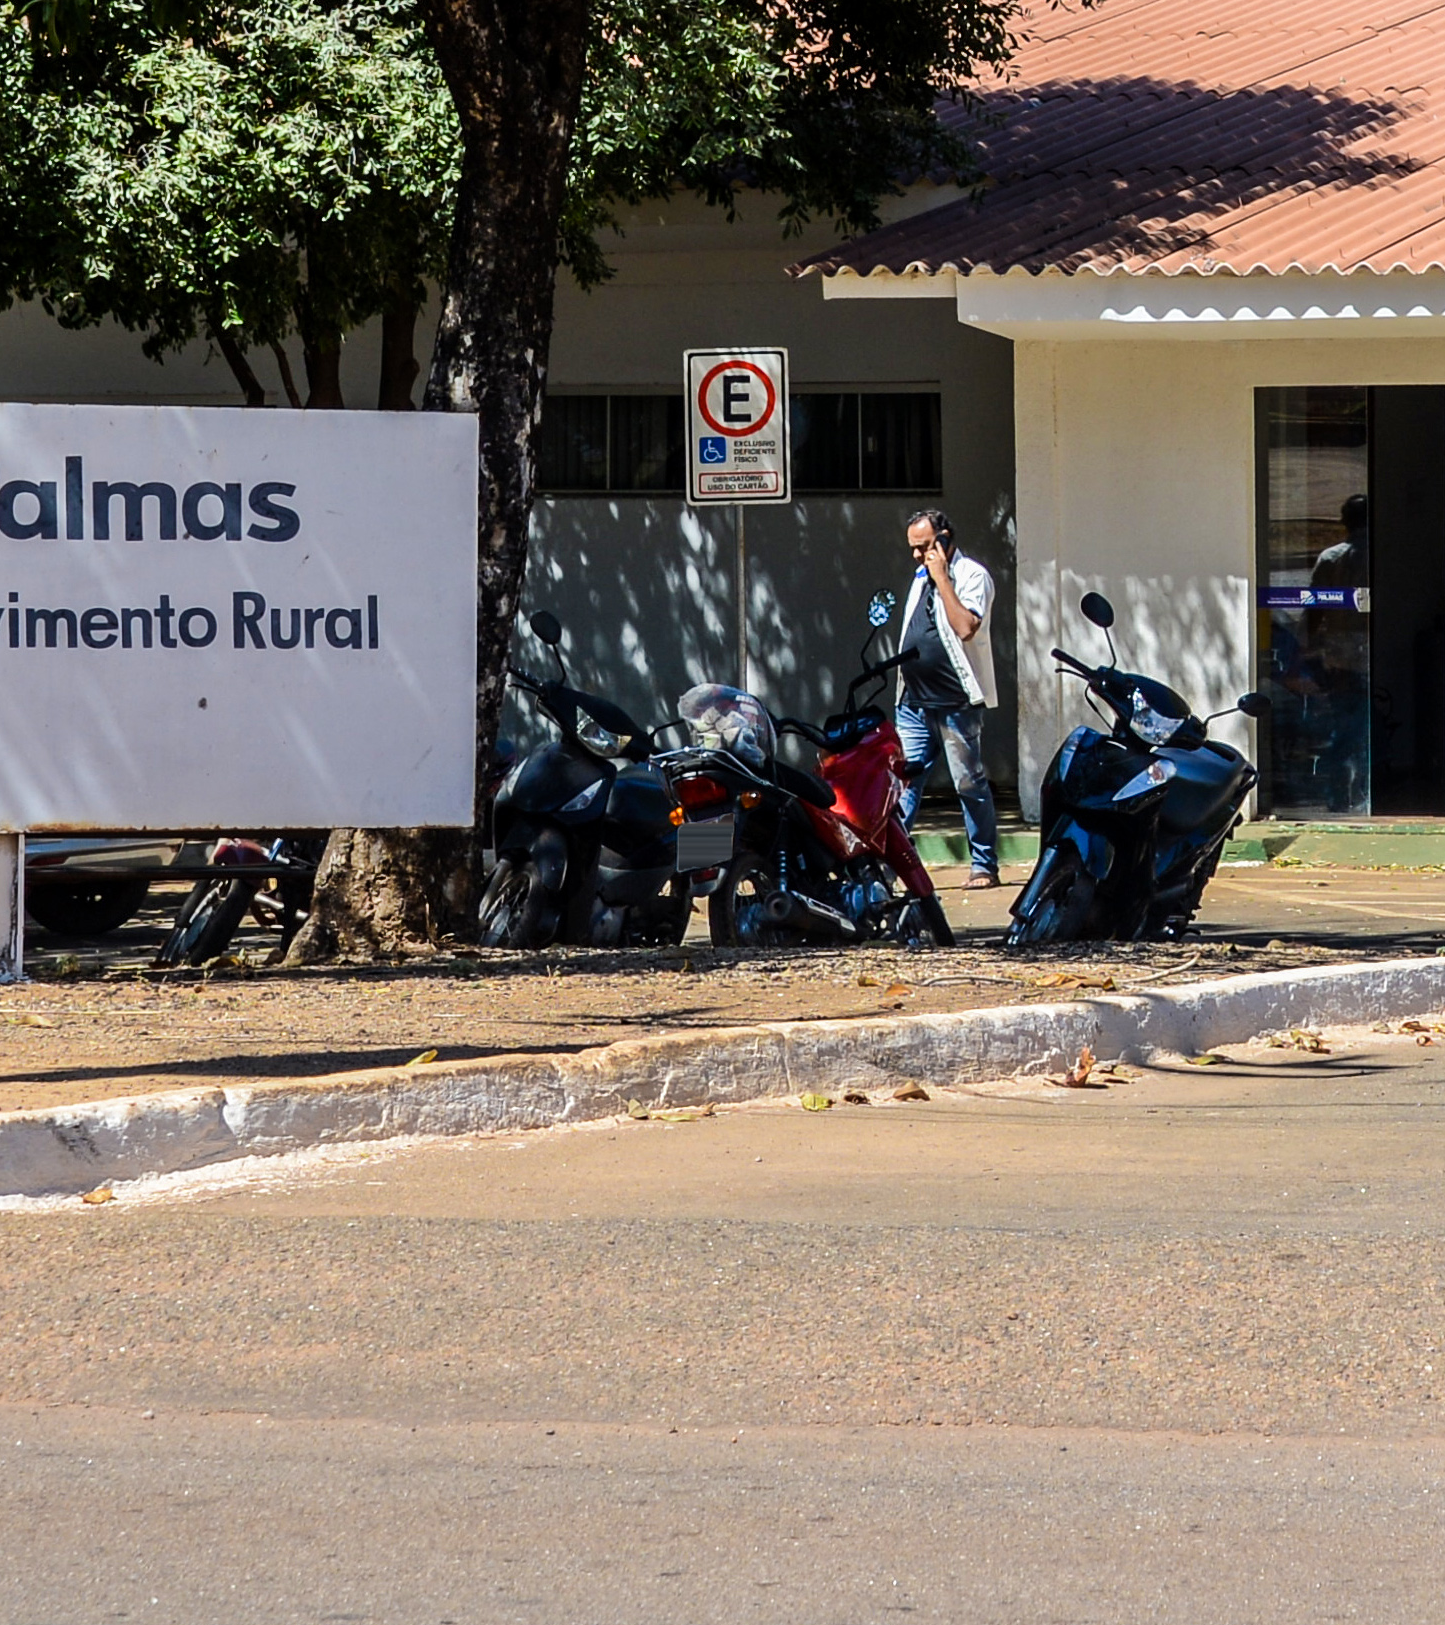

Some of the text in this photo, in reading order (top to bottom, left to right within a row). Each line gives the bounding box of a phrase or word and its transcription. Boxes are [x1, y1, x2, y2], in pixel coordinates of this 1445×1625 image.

[723, 375, 752, 423] E
[734, 440, 775, 448] EXCLUSIVO
[707, 483, 724, 491] USO
[738, 481, 769, 490] CARTÃO
[231, 590, 380, 651] Rural
